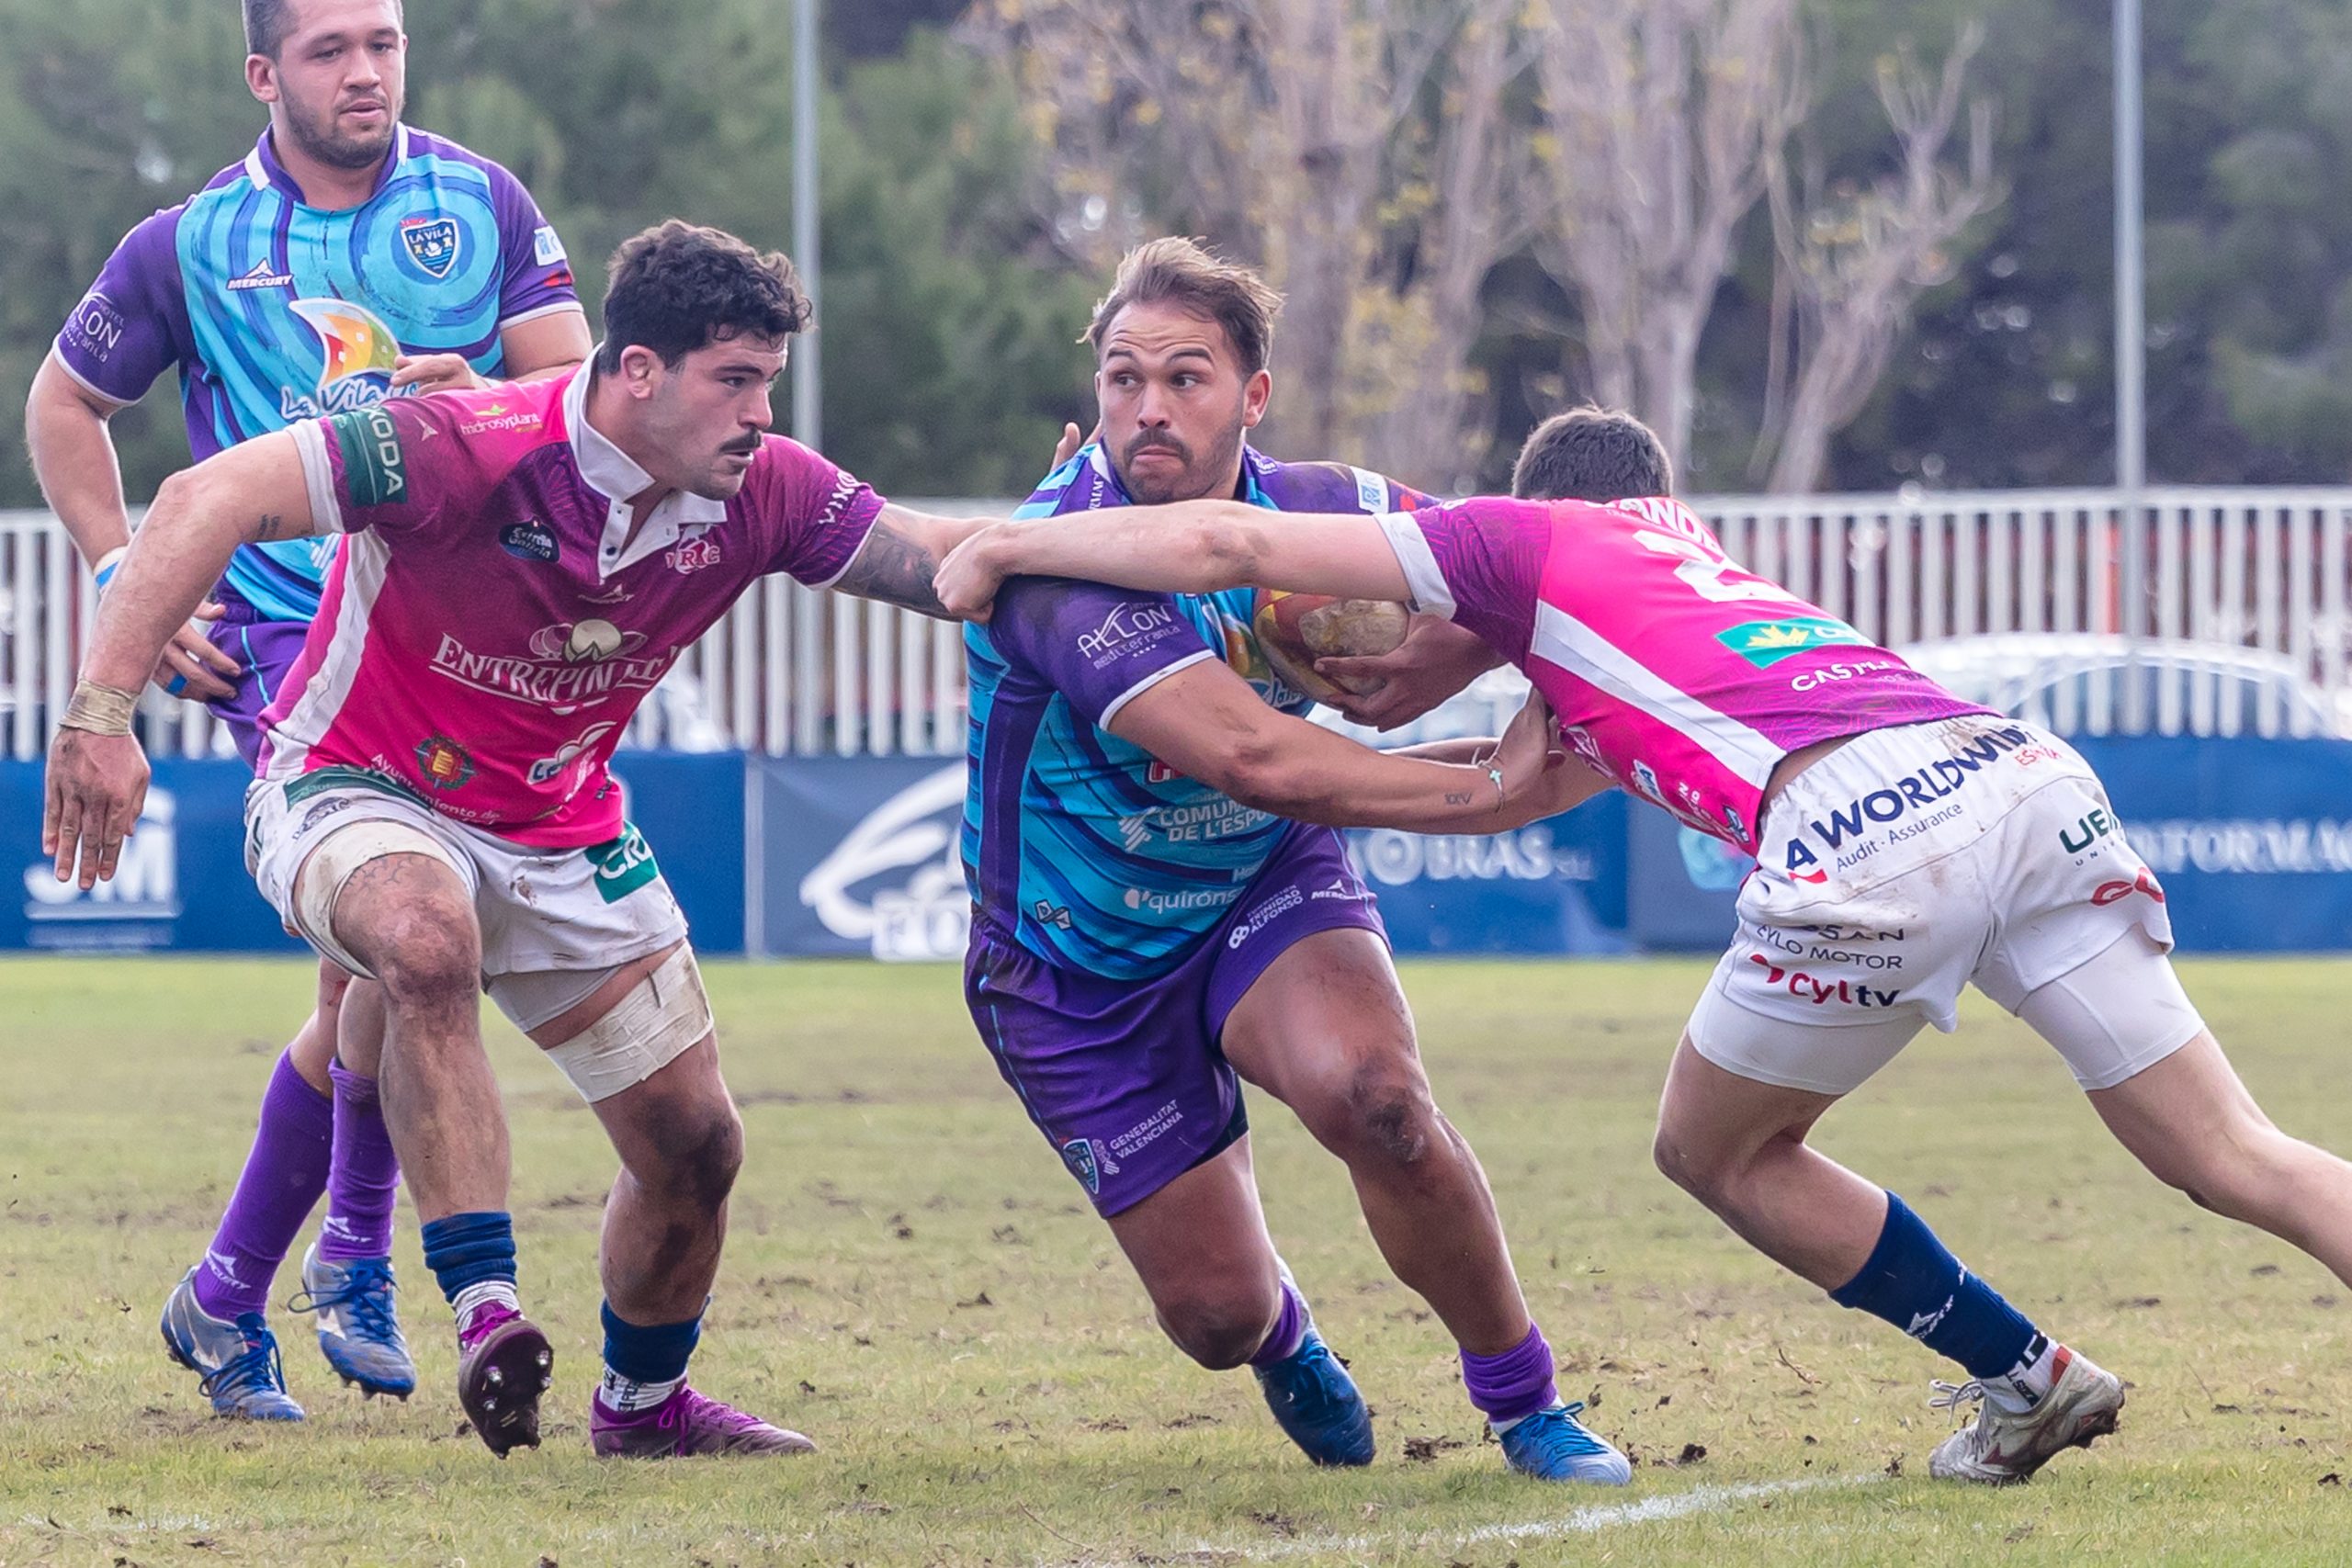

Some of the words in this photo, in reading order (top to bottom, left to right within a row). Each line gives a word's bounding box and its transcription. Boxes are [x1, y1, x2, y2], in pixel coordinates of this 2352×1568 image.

[424, 226, 453, 241] VILA
[227, 275, 292, 289] MERCURY
[1811, 724, 2038, 851] WORLDWID
[1159, 799, 1248, 828] COMUN
[1169, 826, 1199, 843] DE
[1837, 840, 1880, 873] Audit
[1888, 801, 1964, 846] Assurance
[1148, 886, 1240, 915] quiróns
[1249, 889, 1301, 925] TRINIDAD
[1250, 896, 1304, 934] ALFONSO
[1809, 946, 1904, 970] MOTOR
[1788, 972, 1901, 1008] cyltv
[1109, 1099, 1178, 1151] GENERALITAT
[1115, 1111, 1184, 1160] VALENCIANA
